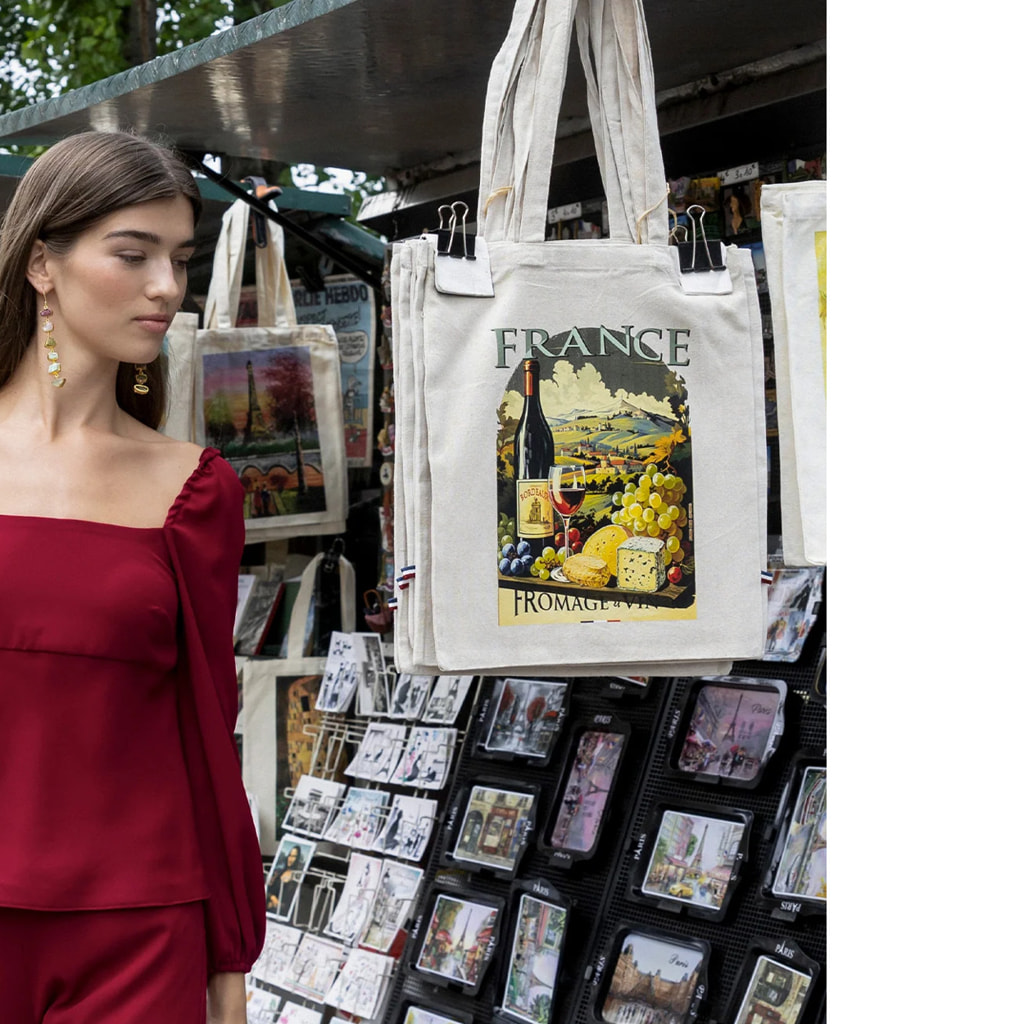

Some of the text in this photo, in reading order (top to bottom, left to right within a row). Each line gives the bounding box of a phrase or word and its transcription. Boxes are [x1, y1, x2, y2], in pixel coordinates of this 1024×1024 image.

[324, 283, 369, 305] HEBDO
[491, 324, 692, 369] FRANCE
[514, 589, 609, 616] FROMAGE
[479, 699, 490, 722] PARIS
[447, 806, 458, 831] PARIS
[634, 833, 647, 861] PARIS
[533, 880, 550, 896] PARIS
[412, 915, 423, 939] PARIS
[775, 940, 795, 959] PARIS
